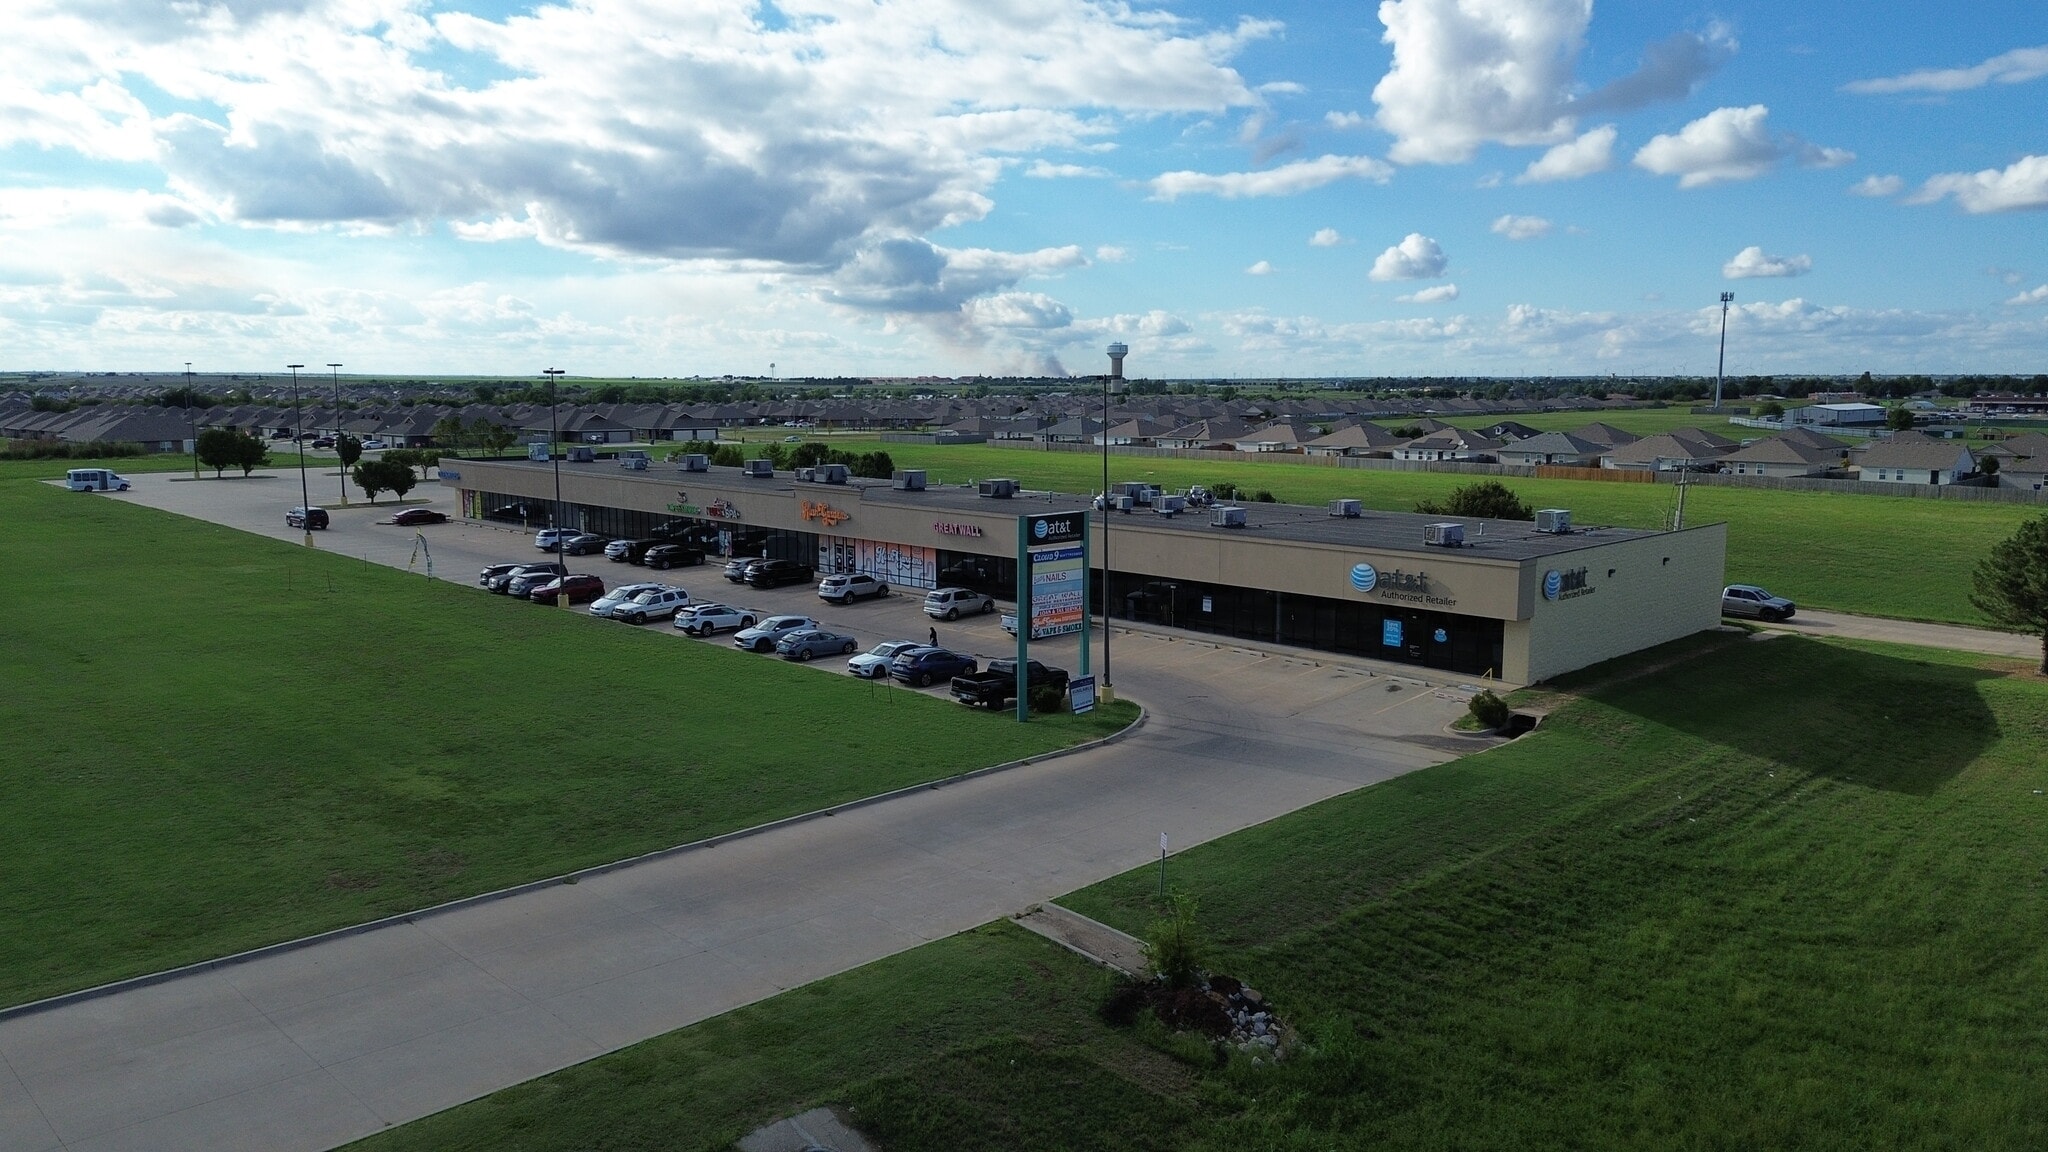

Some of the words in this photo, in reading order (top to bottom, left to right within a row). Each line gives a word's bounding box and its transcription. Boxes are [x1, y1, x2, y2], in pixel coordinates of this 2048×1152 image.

[934, 522, 958, 535] GREAT
[959, 524, 982, 537] WALL
[1048, 519, 1071, 534] at&t
[1054, 550, 1060, 561] 9
[1045, 571, 1067, 582] NAILS
[1380, 569, 1428, 594] at&t
[1560, 566, 1588, 592] at&t
[1061, 591, 1081, 599] WALL
[1381, 590, 1423, 603] Authorized
[1425, 595, 1457, 606] Retailer
[1042, 626, 1057, 636] VAPE
[1062, 622, 1082, 633] SMOKE
